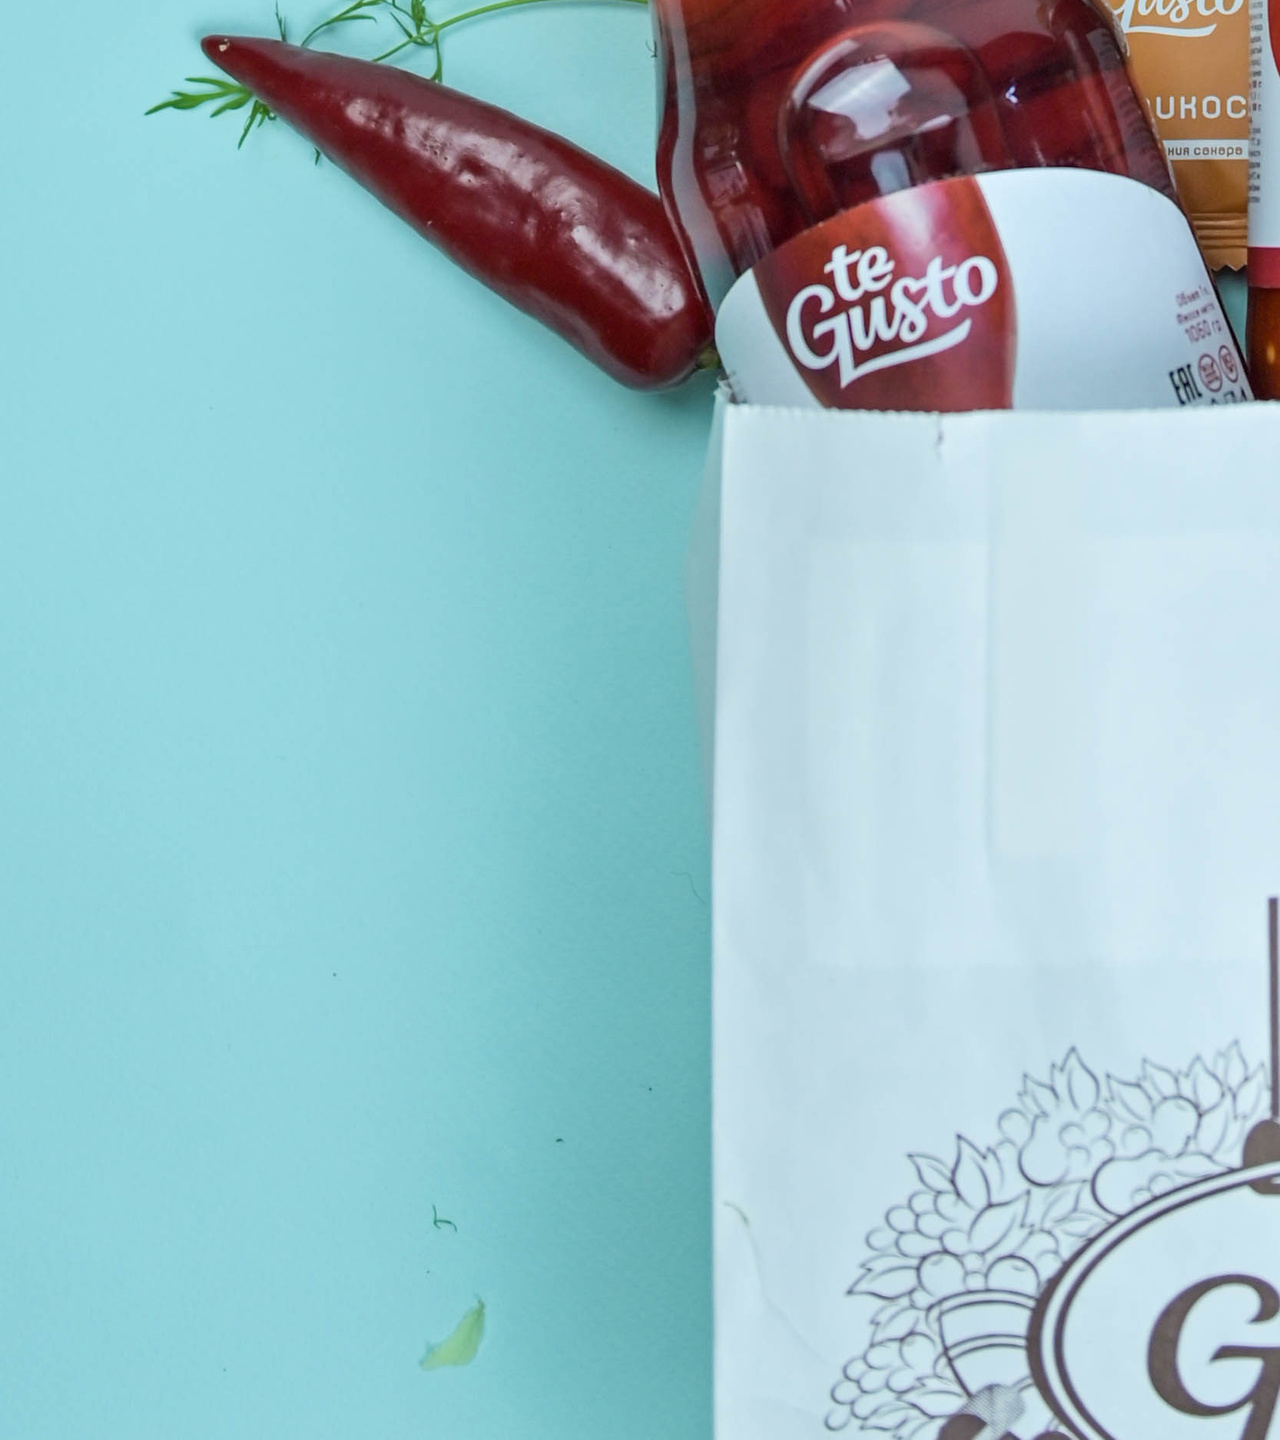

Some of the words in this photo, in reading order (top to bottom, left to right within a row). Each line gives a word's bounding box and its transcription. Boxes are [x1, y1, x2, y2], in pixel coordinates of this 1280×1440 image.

[1146, 95, 1247, 119] ИКОС
[1167, 146, 1190, 156] ния
[824, 244, 895, 301] te
[786, 255, 998, 389] Gusto
